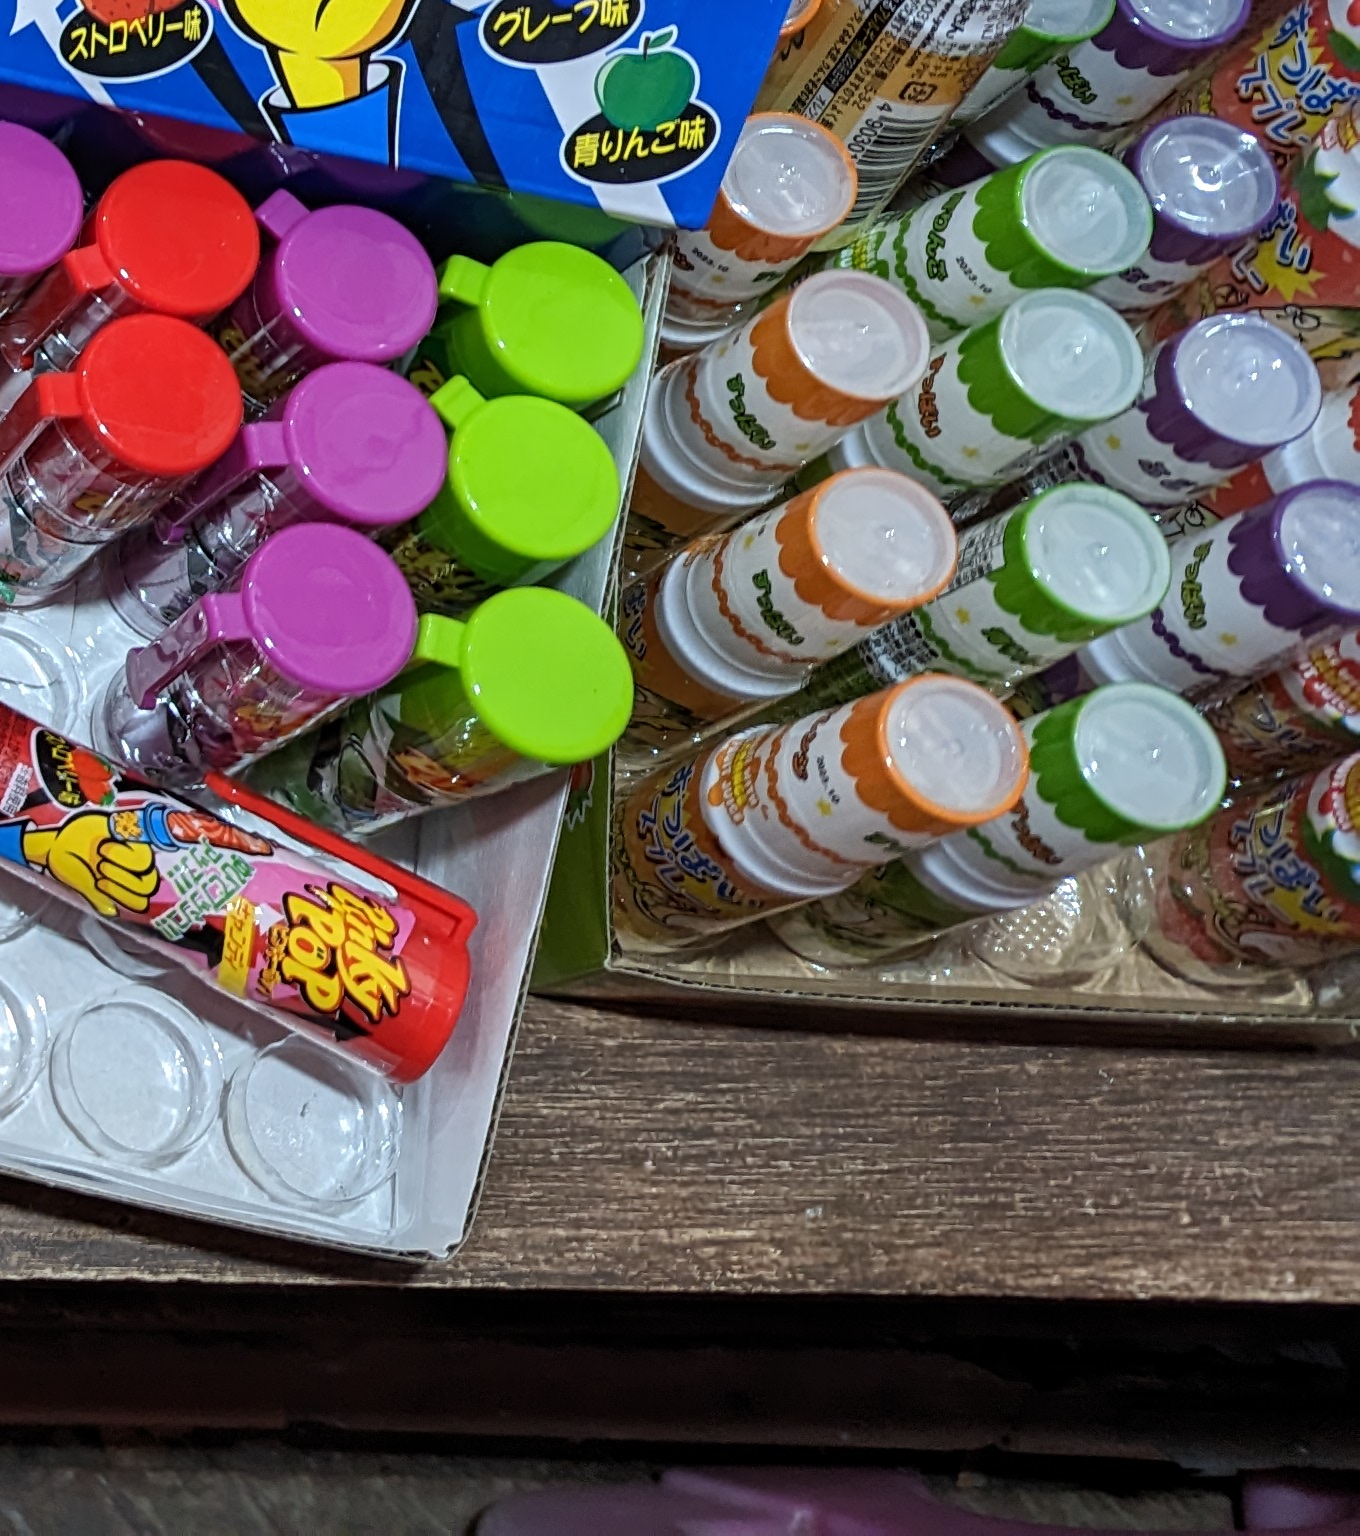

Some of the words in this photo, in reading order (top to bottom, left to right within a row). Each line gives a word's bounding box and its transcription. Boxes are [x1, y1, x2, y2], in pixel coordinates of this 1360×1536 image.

[69, 8, 202, 66] ストロベリー味
[574, 128, 705, 174] 青りんご味
